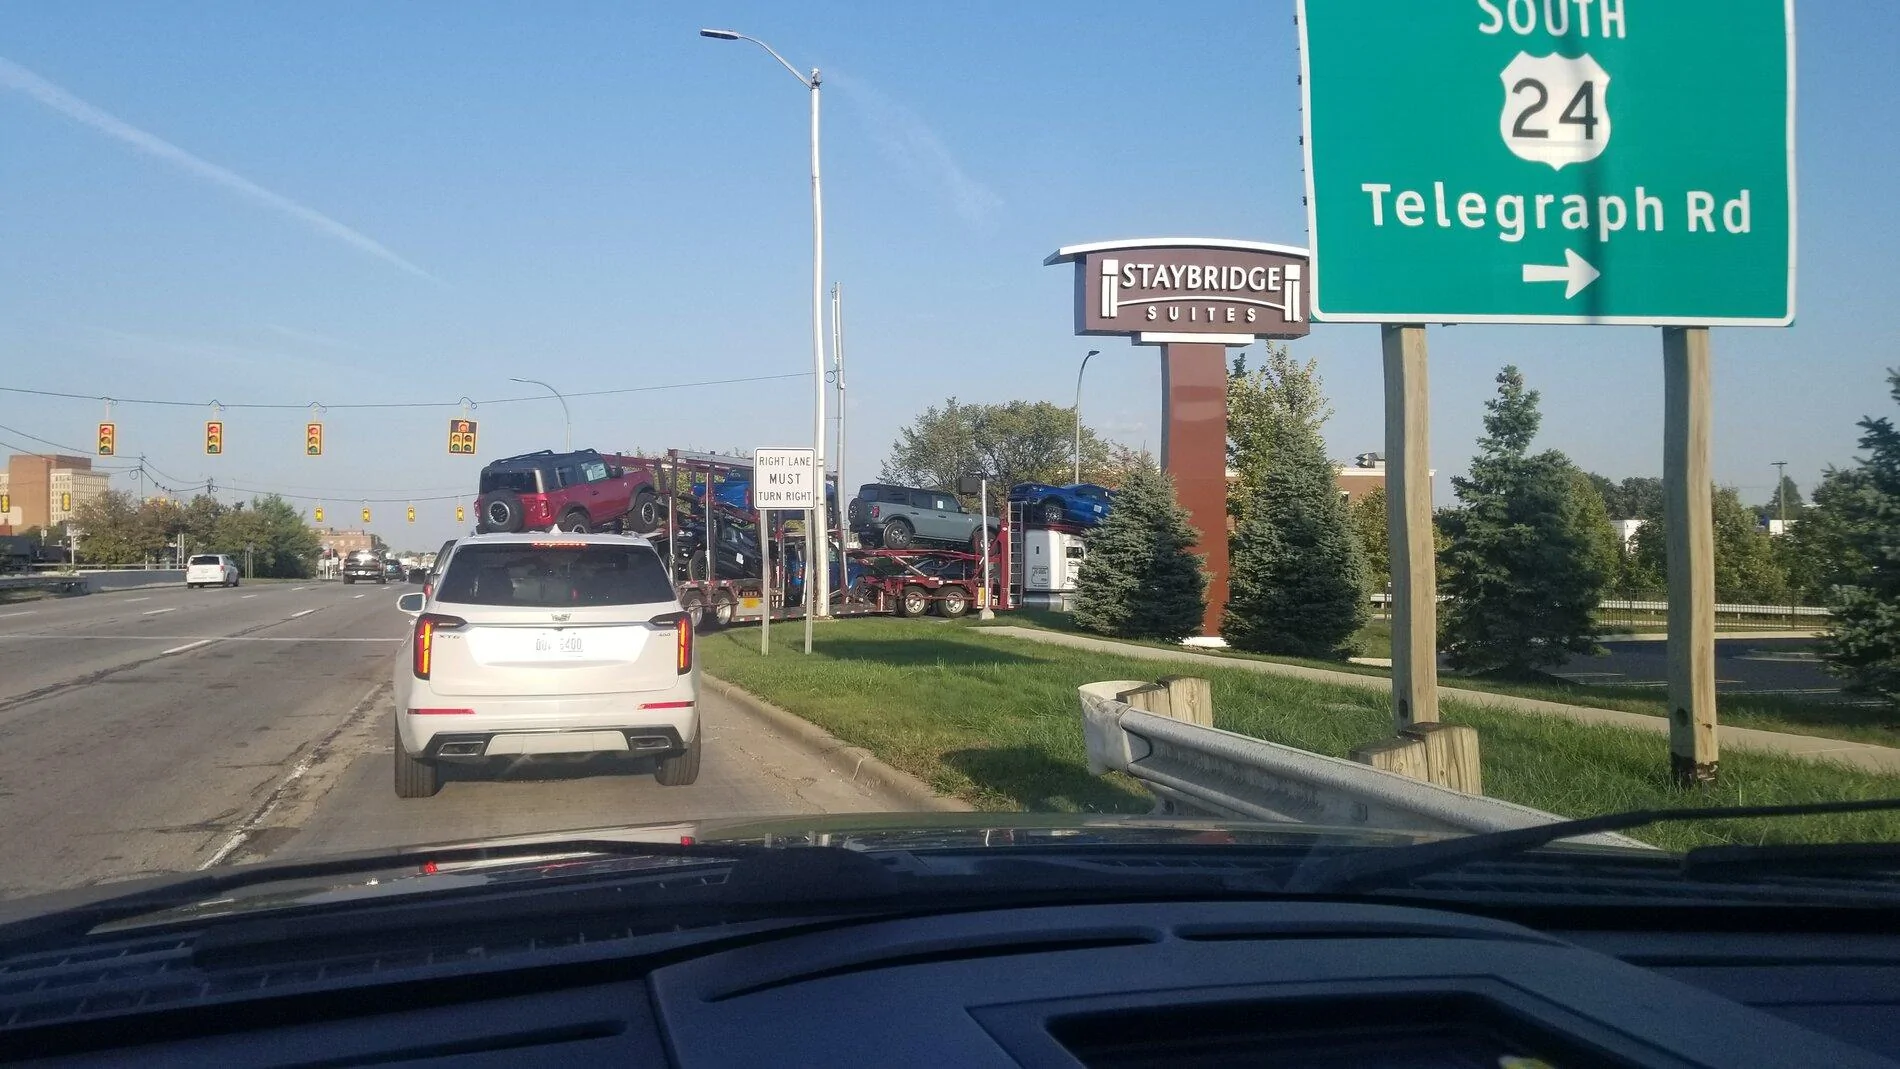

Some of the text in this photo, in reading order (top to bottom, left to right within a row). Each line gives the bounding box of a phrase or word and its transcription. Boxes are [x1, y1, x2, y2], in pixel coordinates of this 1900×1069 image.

[1477, 0, 1626, 39] SOUTH
[1511, 78, 1599, 140] 24
[1361, 181, 1751, 243] Telegraph Rd
[1121, 263, 1281, 292] STAYBRIDGE
[1147, 306, 1257, 322] SUITES
[758, 456, 811, 467] RIGHT LANE
[769, 473, 801, 485] MUST
[758, 491, 811, 501] TURN RIGHT
